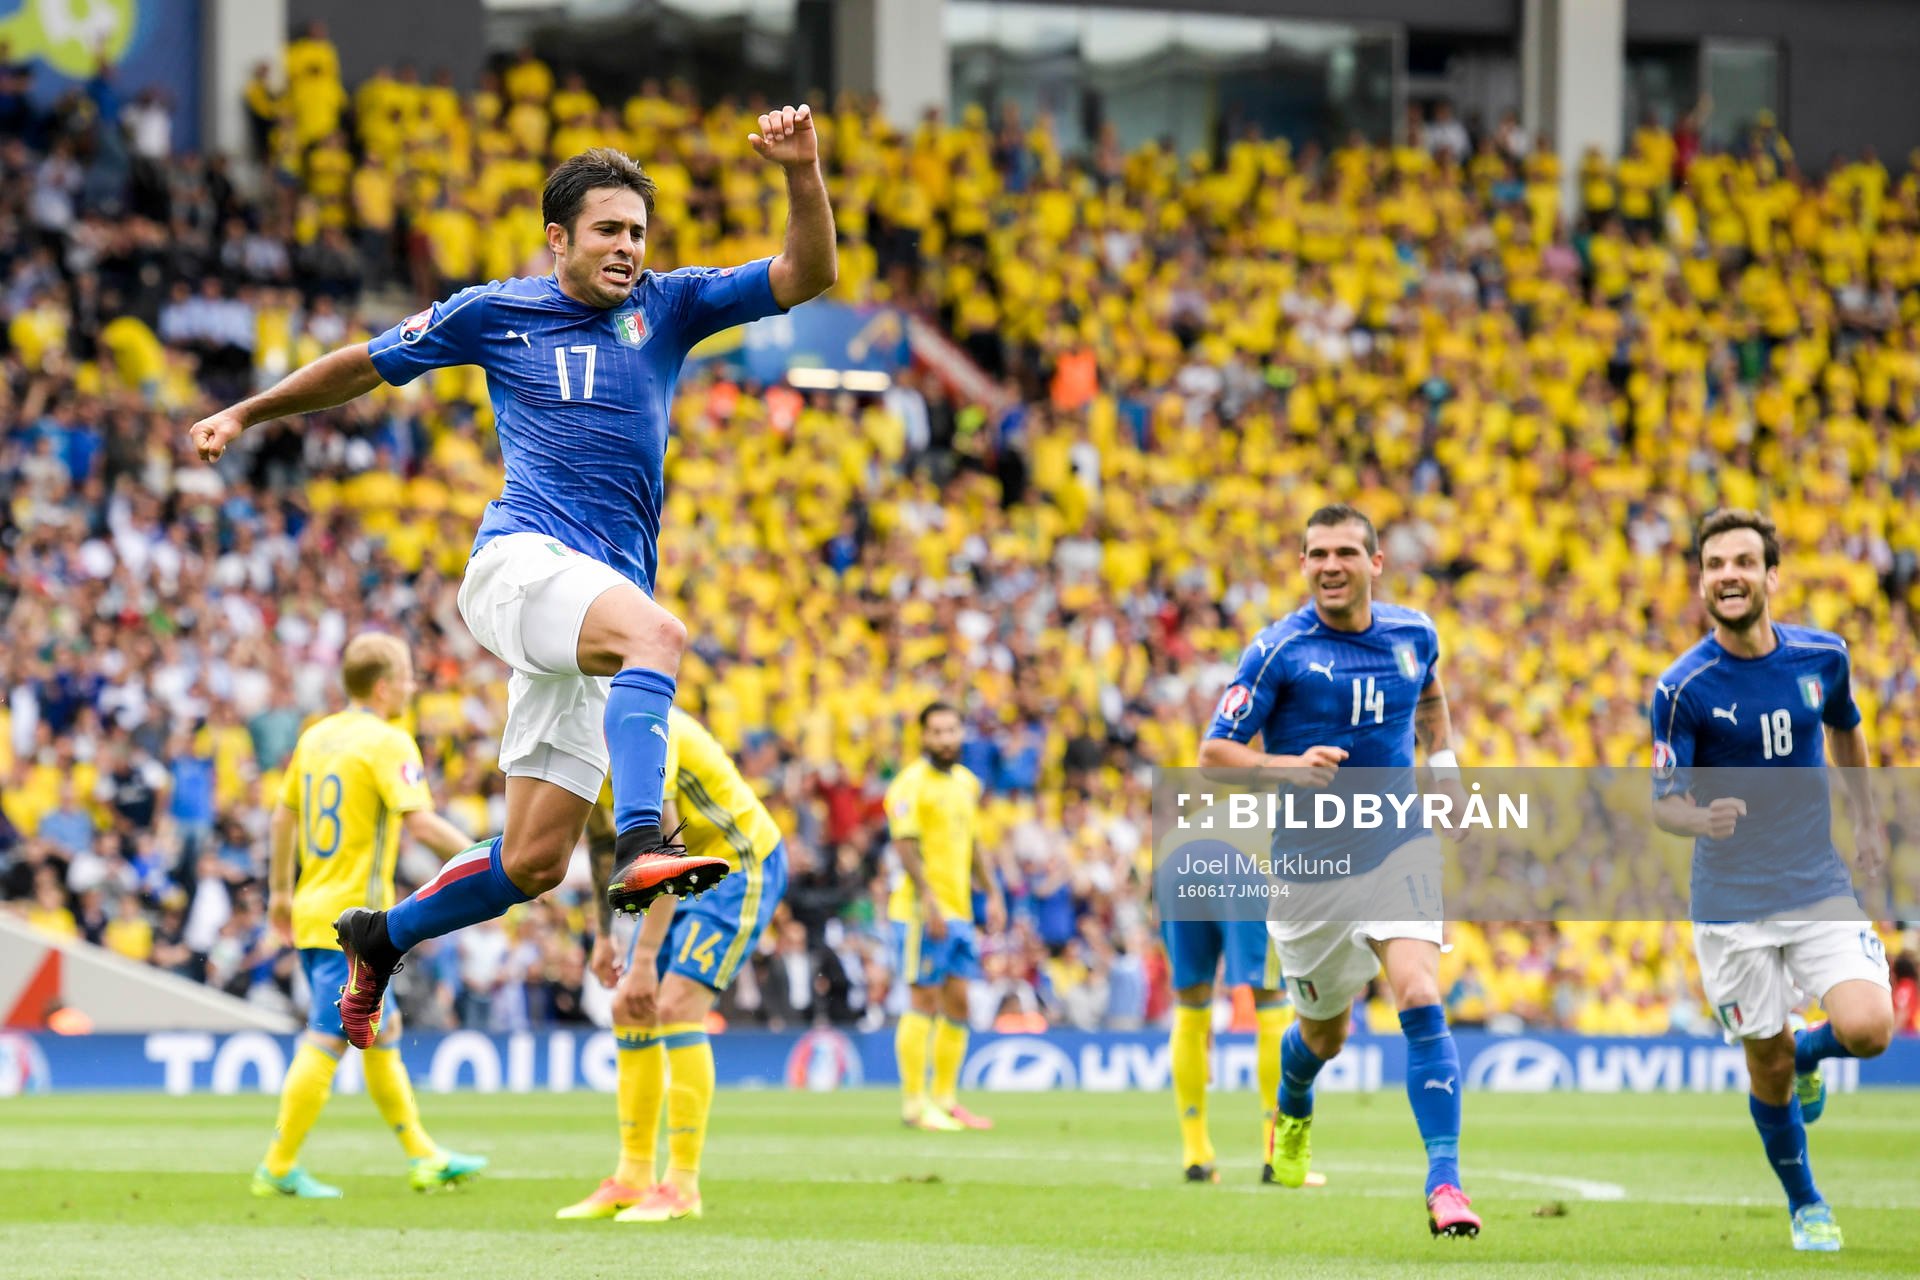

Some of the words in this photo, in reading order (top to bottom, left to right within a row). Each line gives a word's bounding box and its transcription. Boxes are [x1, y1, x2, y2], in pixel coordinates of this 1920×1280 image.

[555, 345, 597, 400] 17
[1351, 676, 1384, 726] 14
[1760, 708, 1793, 760] 18
[304, 773, 342, 859] 18
[678, 921, 722, 974] 14
